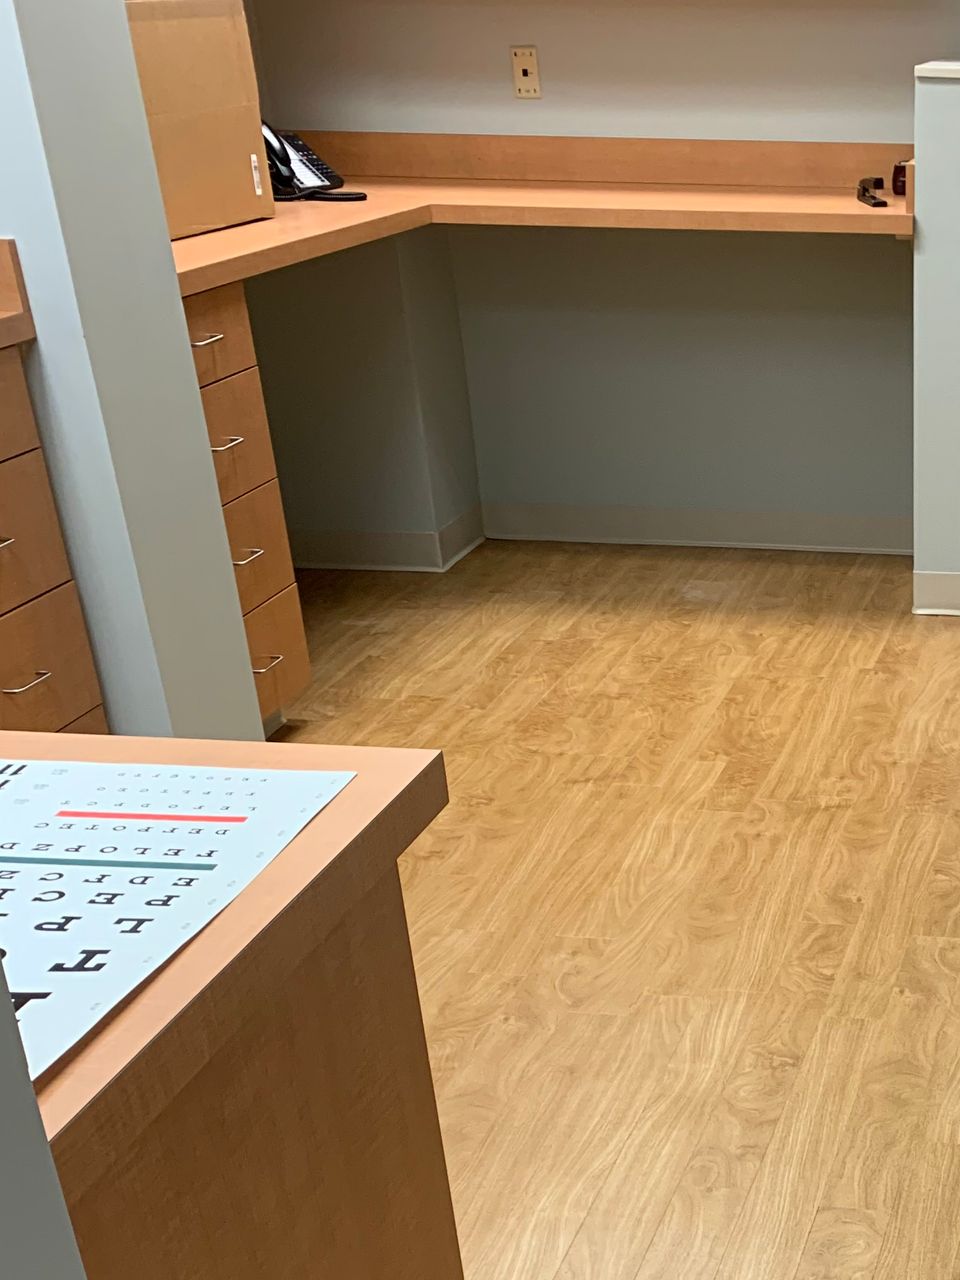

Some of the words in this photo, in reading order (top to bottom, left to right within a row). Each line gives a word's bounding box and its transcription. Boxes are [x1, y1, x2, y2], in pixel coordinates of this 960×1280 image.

[84, 823, 100, 831] T
[161, 826, 180, 834] F
[187, 827, 205, 835] E
[214, 828, 231, 836] D
[29, 842, 55, 852] Z
[63, 844, 87, 853] P
[98, 845, 119, 854] O
[132, 846, 153, 856] L
[161, 847, 187, 857] E
[194, 849, 220, 858] F
[37, 871, 65, 882] C
[81, 873, 113, 884] F
[127, 875, 156, 886] D
[170, 876, 201, 888] E
[30, 890, 66, 902] C
[86, 892, 125, 905] E
[144, 895, 181, 907] P
[33, 916, 83, 932] P
[113, 918, 155, 934] L
[46, 949, 112, 972] T
